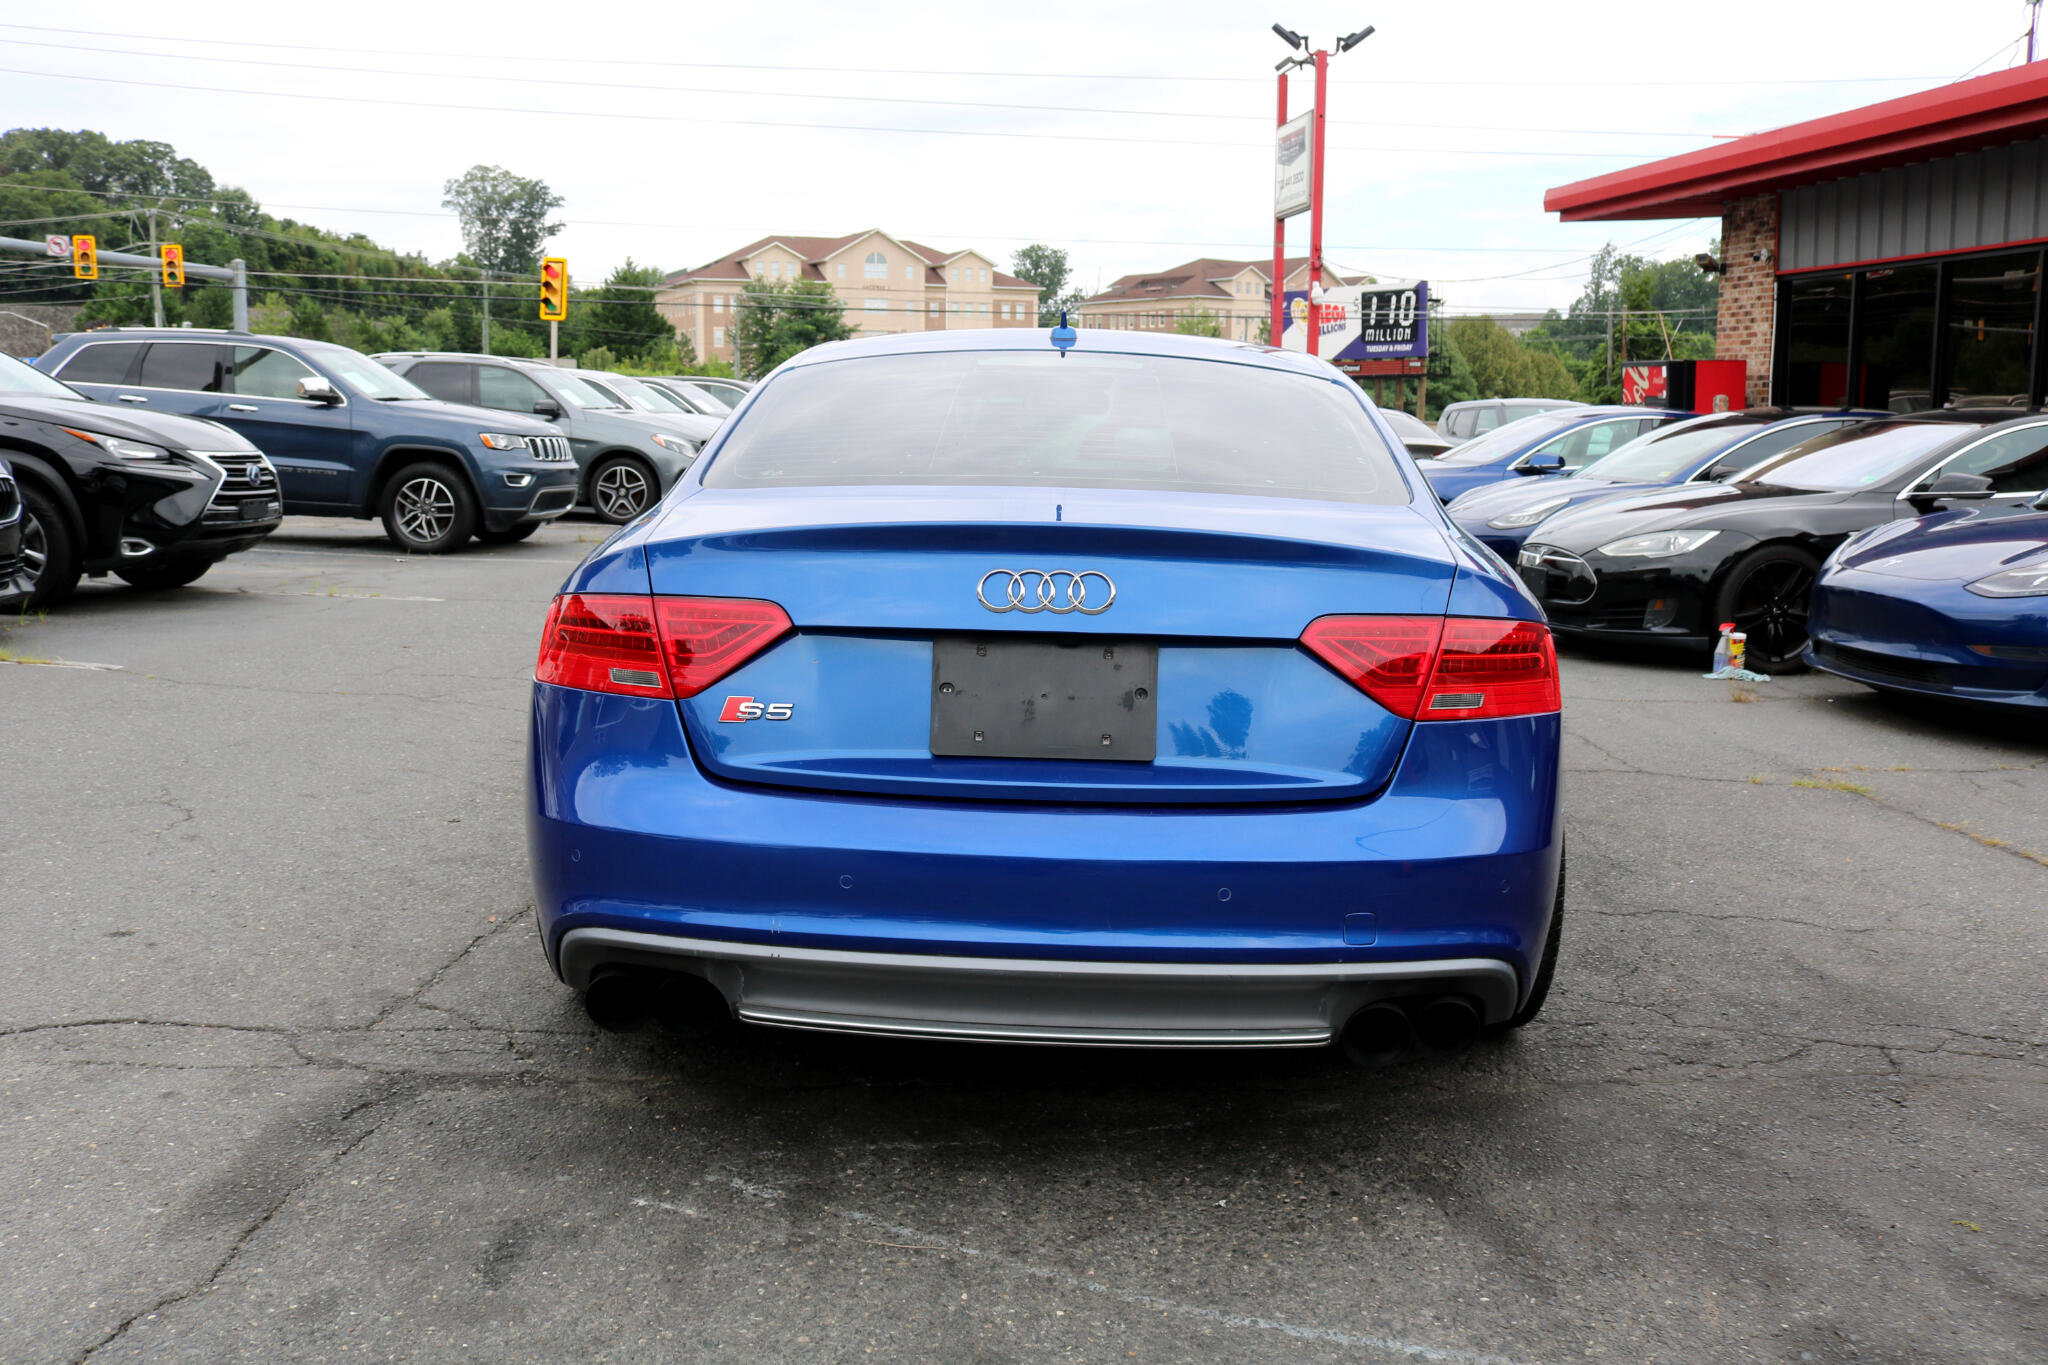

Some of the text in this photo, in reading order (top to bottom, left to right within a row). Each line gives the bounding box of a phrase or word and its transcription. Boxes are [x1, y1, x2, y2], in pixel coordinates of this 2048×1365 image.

[1369, 290, 1417, 327] 110
[1365, 328, 1411, 342] MILLION
[1366, 345, 1388, 353] TUESDAY
[1393, 344, 1413, 352] FRIDAY
[736, 702, 795, 721] S5
